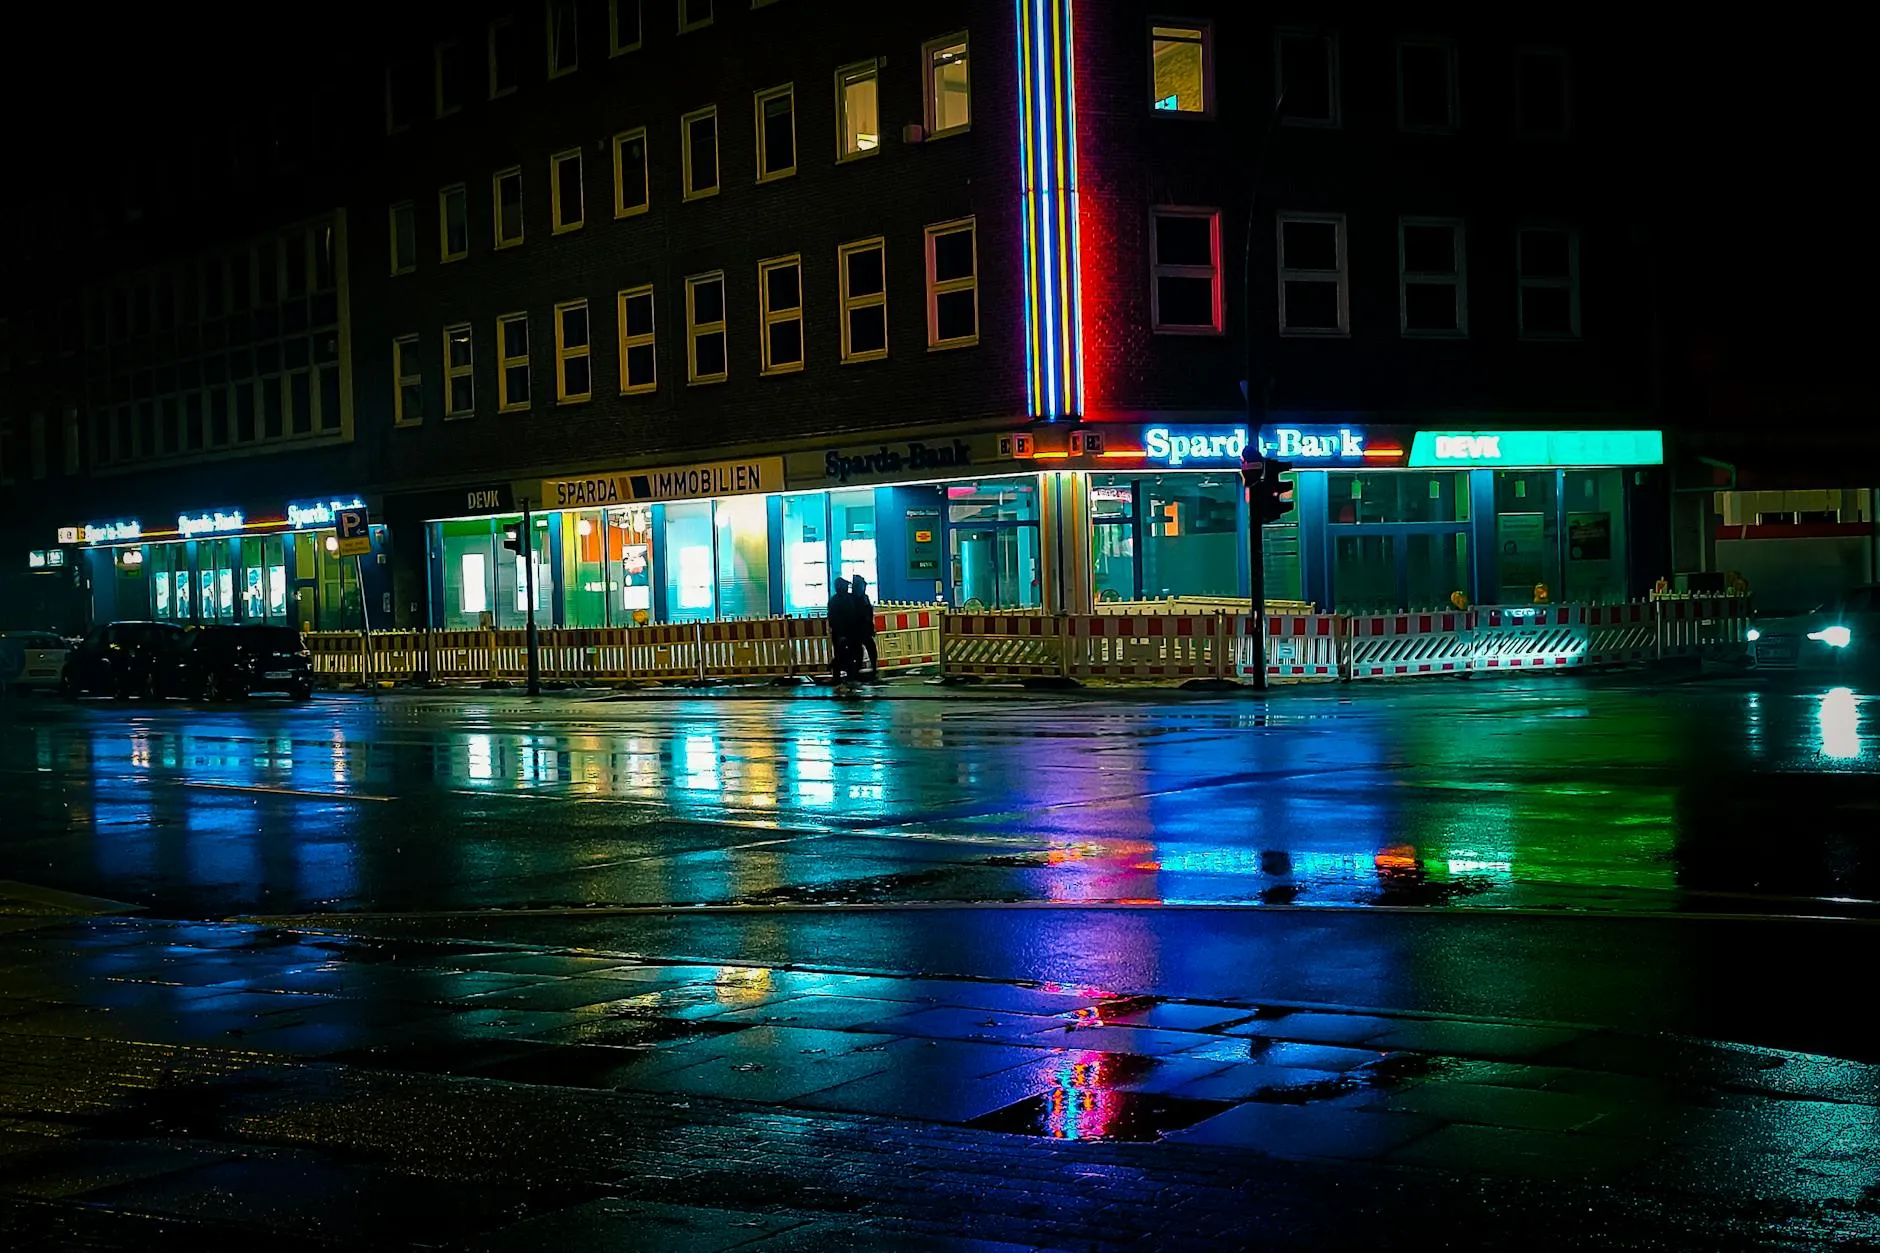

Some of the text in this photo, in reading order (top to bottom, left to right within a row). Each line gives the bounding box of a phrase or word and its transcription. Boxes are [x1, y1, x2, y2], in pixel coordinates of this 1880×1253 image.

[1435, 435, 1502, 458] DEVK
[826, 438, 971, 482] Sparda-Bank
[557, 464, 760, 505] SPARDA IMMOBILIEN
[467, 489, 500, 510] DEVK
[341, 512, 361, 538] P
